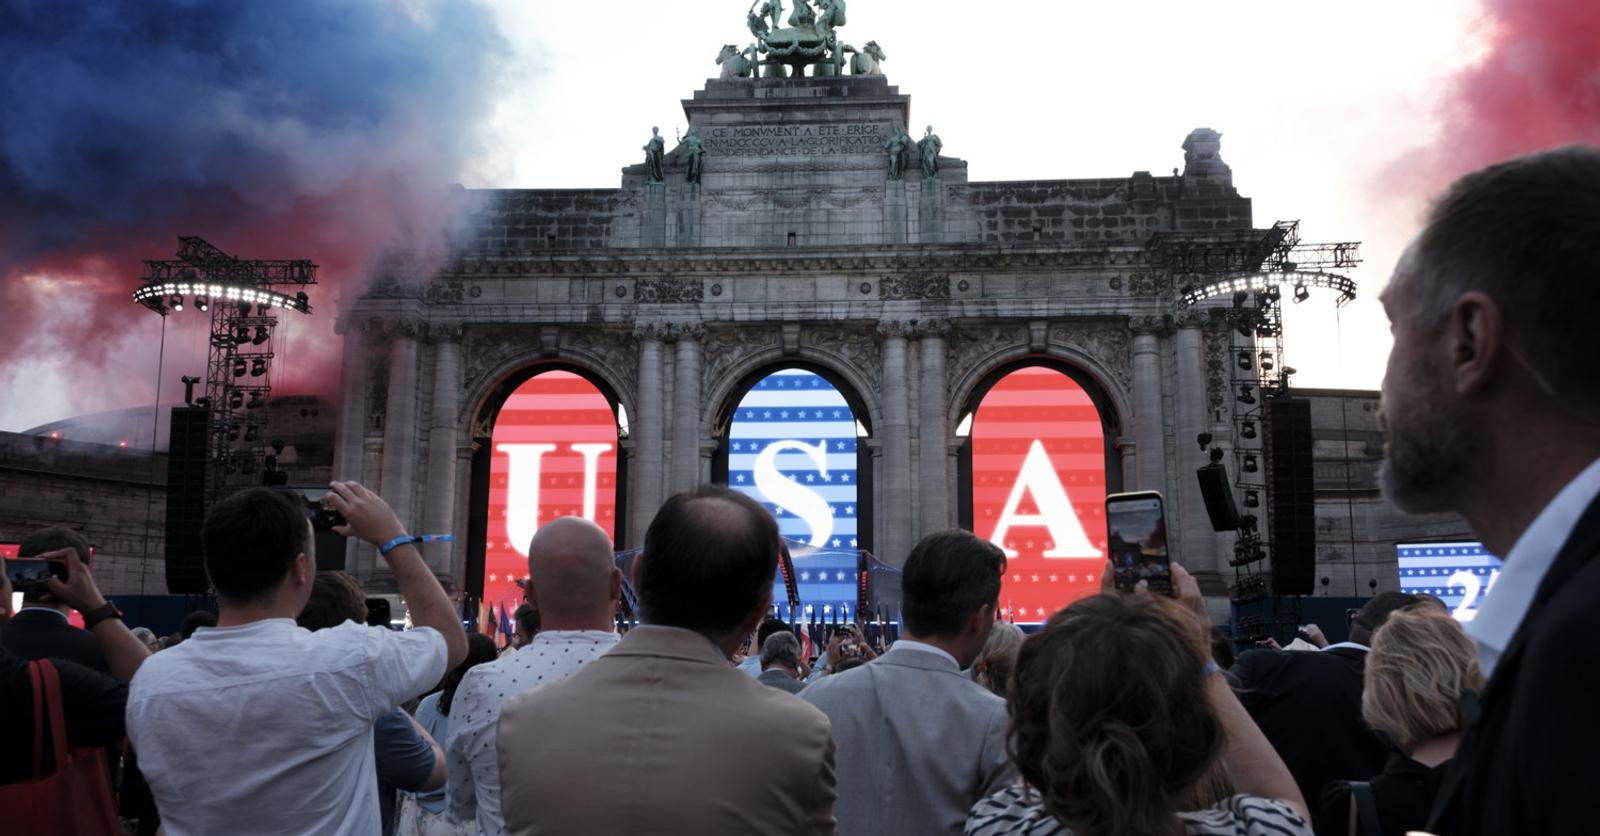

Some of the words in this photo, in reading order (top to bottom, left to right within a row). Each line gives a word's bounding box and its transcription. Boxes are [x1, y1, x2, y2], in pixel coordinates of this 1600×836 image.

[712, 128, 727, 137] CE
[734, 126, 799, 137] MONVMENT
[804, 127, 812, 136] A
[818, 125, 840, 135] ETE
[807, 135, 884, 146] GLORIFICATIO
[754, 440, 834, 557] S
[990, 439, 1103, 558] A
[1447, 569, 1502, 622] 2
